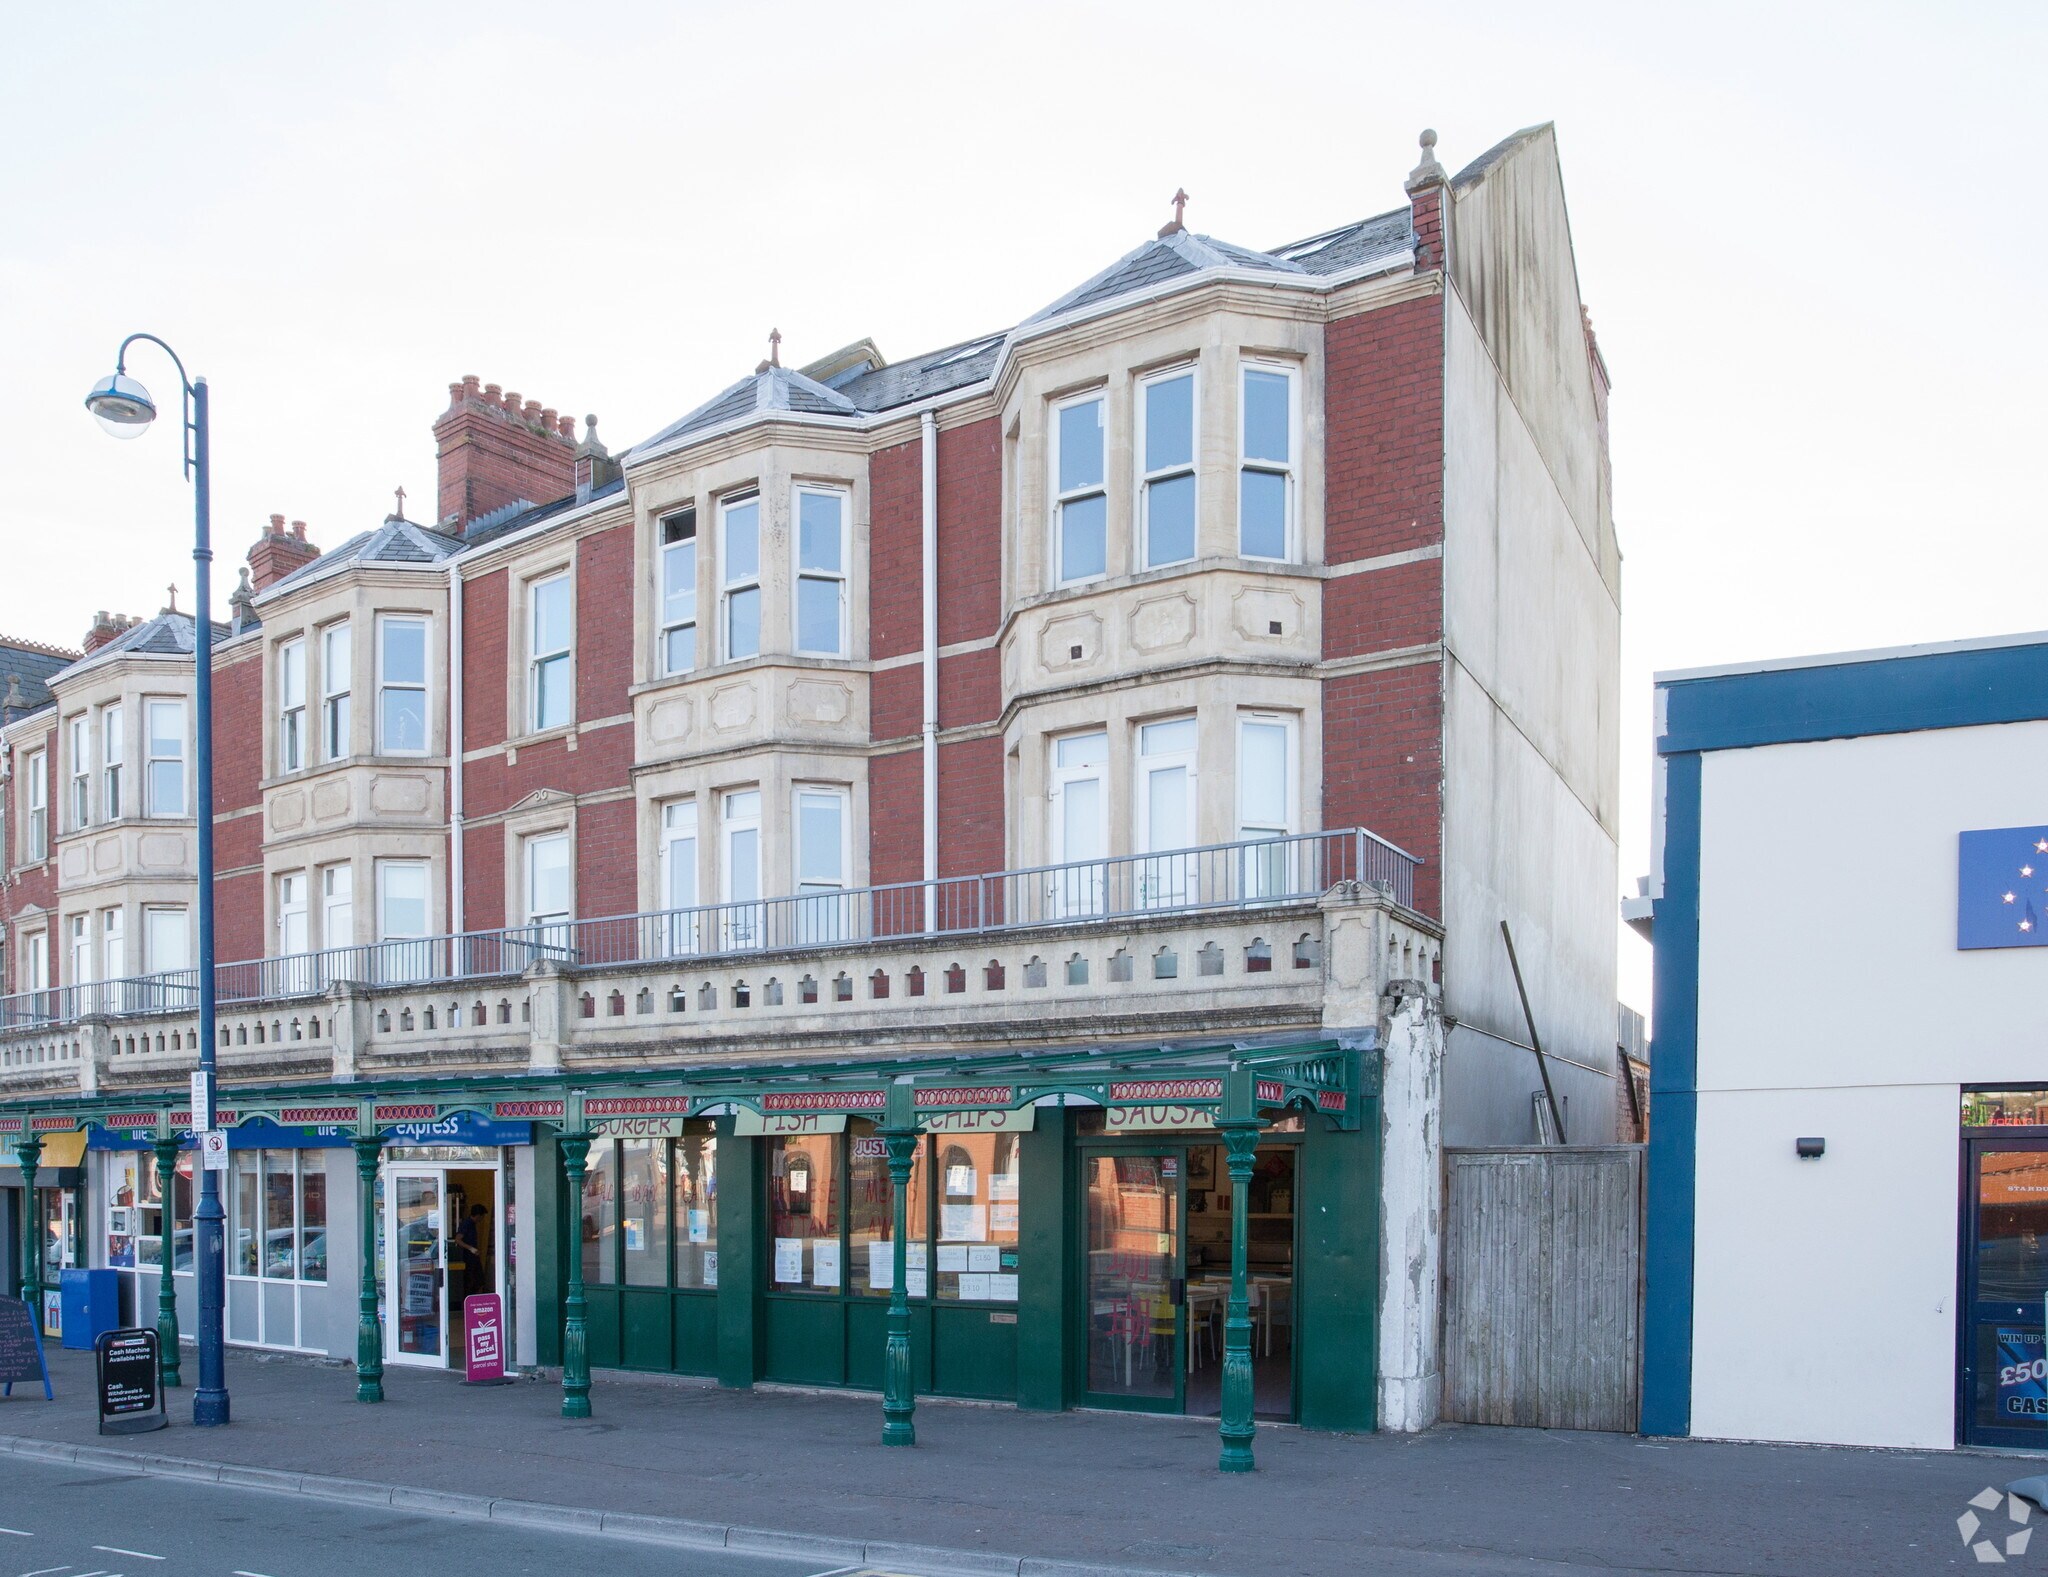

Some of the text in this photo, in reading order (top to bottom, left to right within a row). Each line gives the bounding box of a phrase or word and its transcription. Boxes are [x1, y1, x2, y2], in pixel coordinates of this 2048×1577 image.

[930, 1110, 1007, 1129] CHIPS
[1110, 1105, 1219, 1125] SAUSA
[597, 1117, 671, 1136] BURGER
[762, 1114, 818, 1132] FISH
[396, 1117, 459, 1140] express
[473, 1306, 493, 1314] amazon
[477, 1334, 491, 1342] pass
[1999, 1333, 2023, 1343] WIN
[2024, 1334, 2040, 1344] UP
[480, 1340, 489, 1348] my
[109, 1346, 150, 1356] Cash Machine
[476, 1345, 495, 1356] parcel
[108, 1355, 135, 1363] Available
[472, 1362, 487, 1370] parcel
[2001, 1358, 2047, 1386] £50
[107, 1388, 138, 1397] Withdrawals
[127, 1393, 151, 1401] Enquiries
